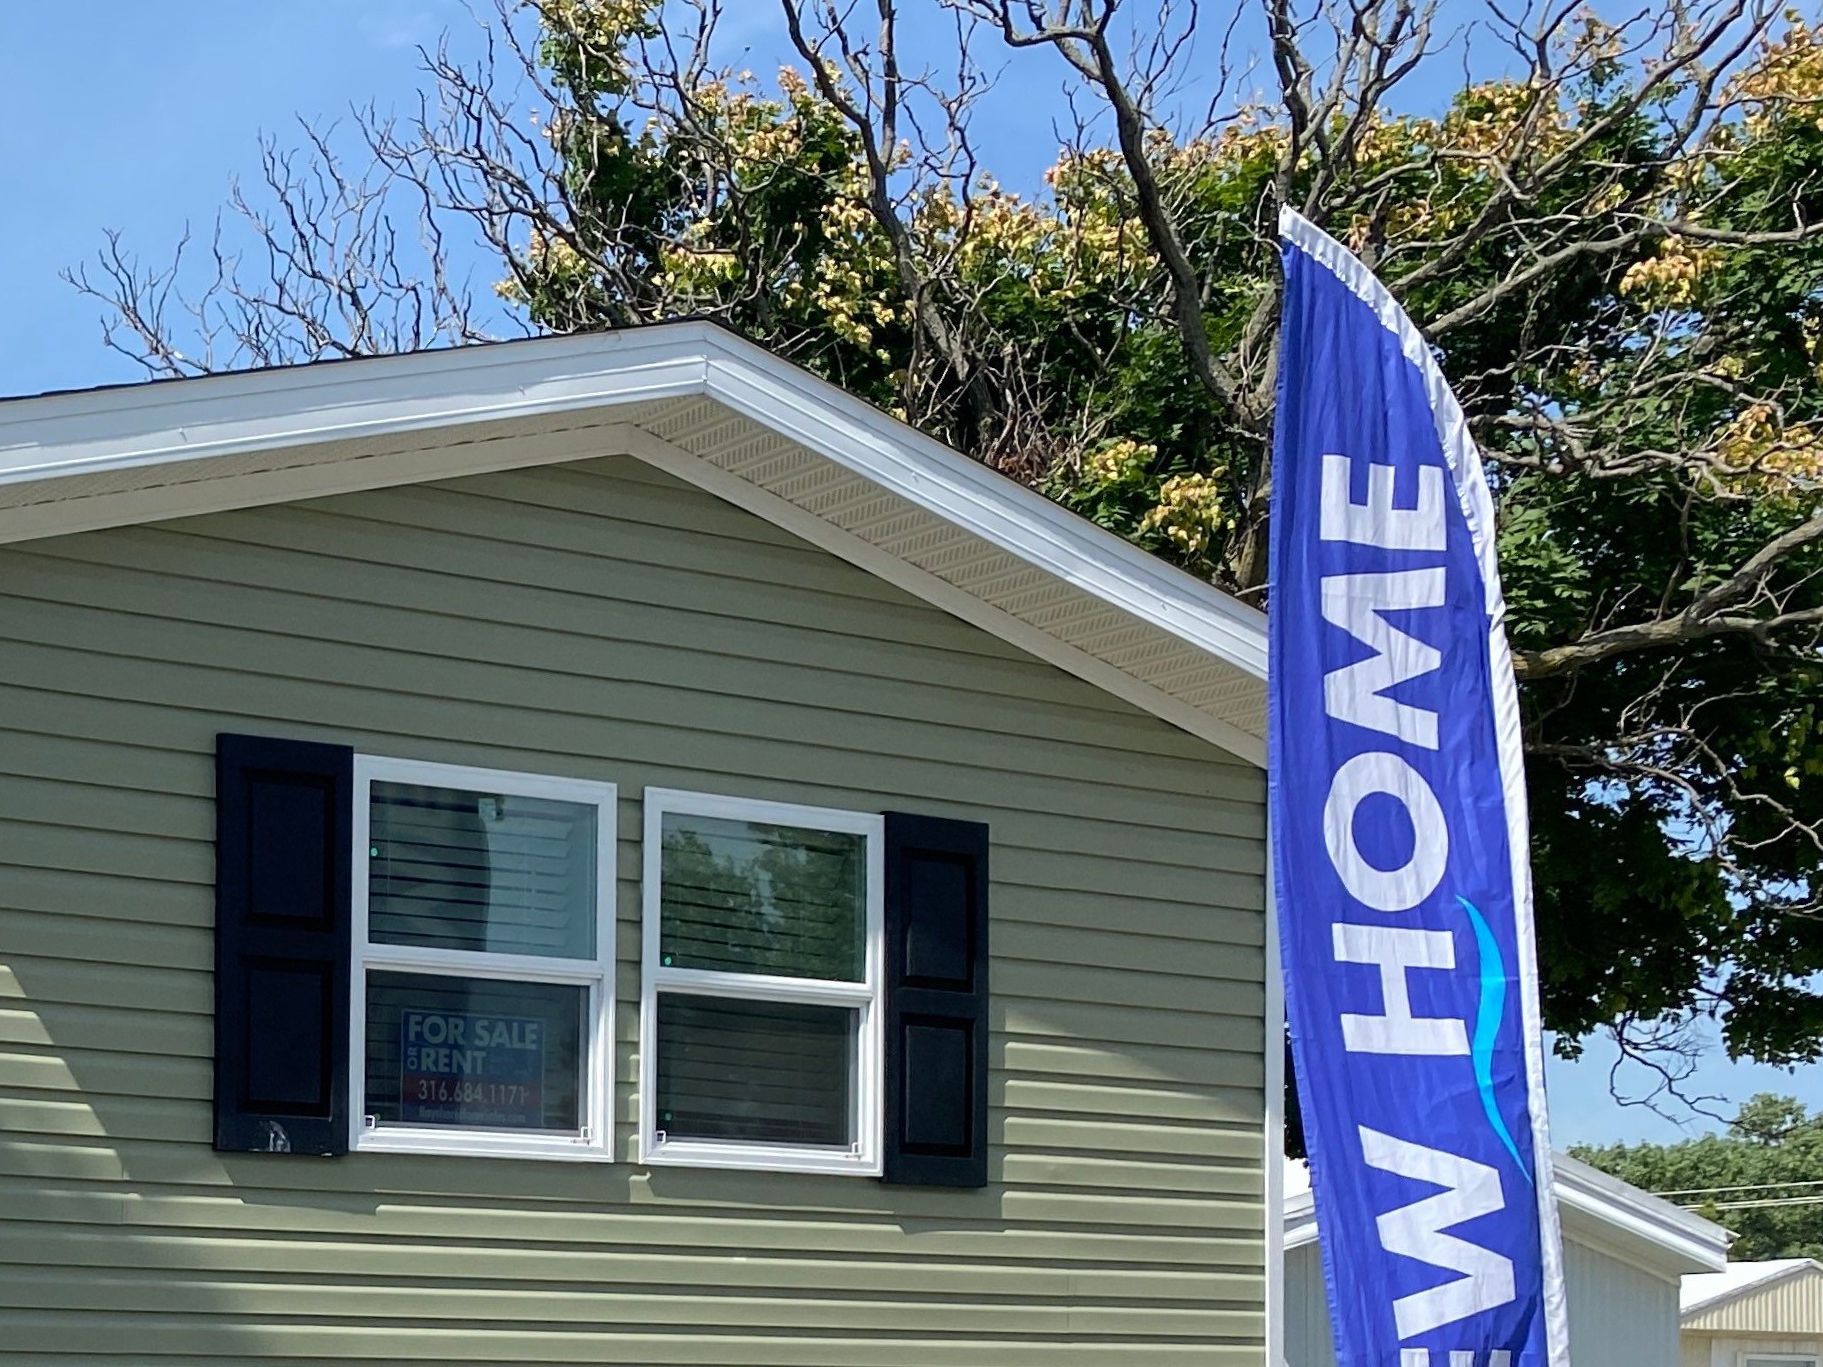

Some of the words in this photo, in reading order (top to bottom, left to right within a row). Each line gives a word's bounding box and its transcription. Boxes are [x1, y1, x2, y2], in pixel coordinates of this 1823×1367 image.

[1319, 453, 1471, 1056] HOME
[408, 1014, 467, 1046] FOR
[474, 1018, 539, 1050] SALE
[407, 1045, 419, 1070] OR
[419, 1047, 488, 1076] RENT
[417, 1079, 526, 1106] 316.684.1171
